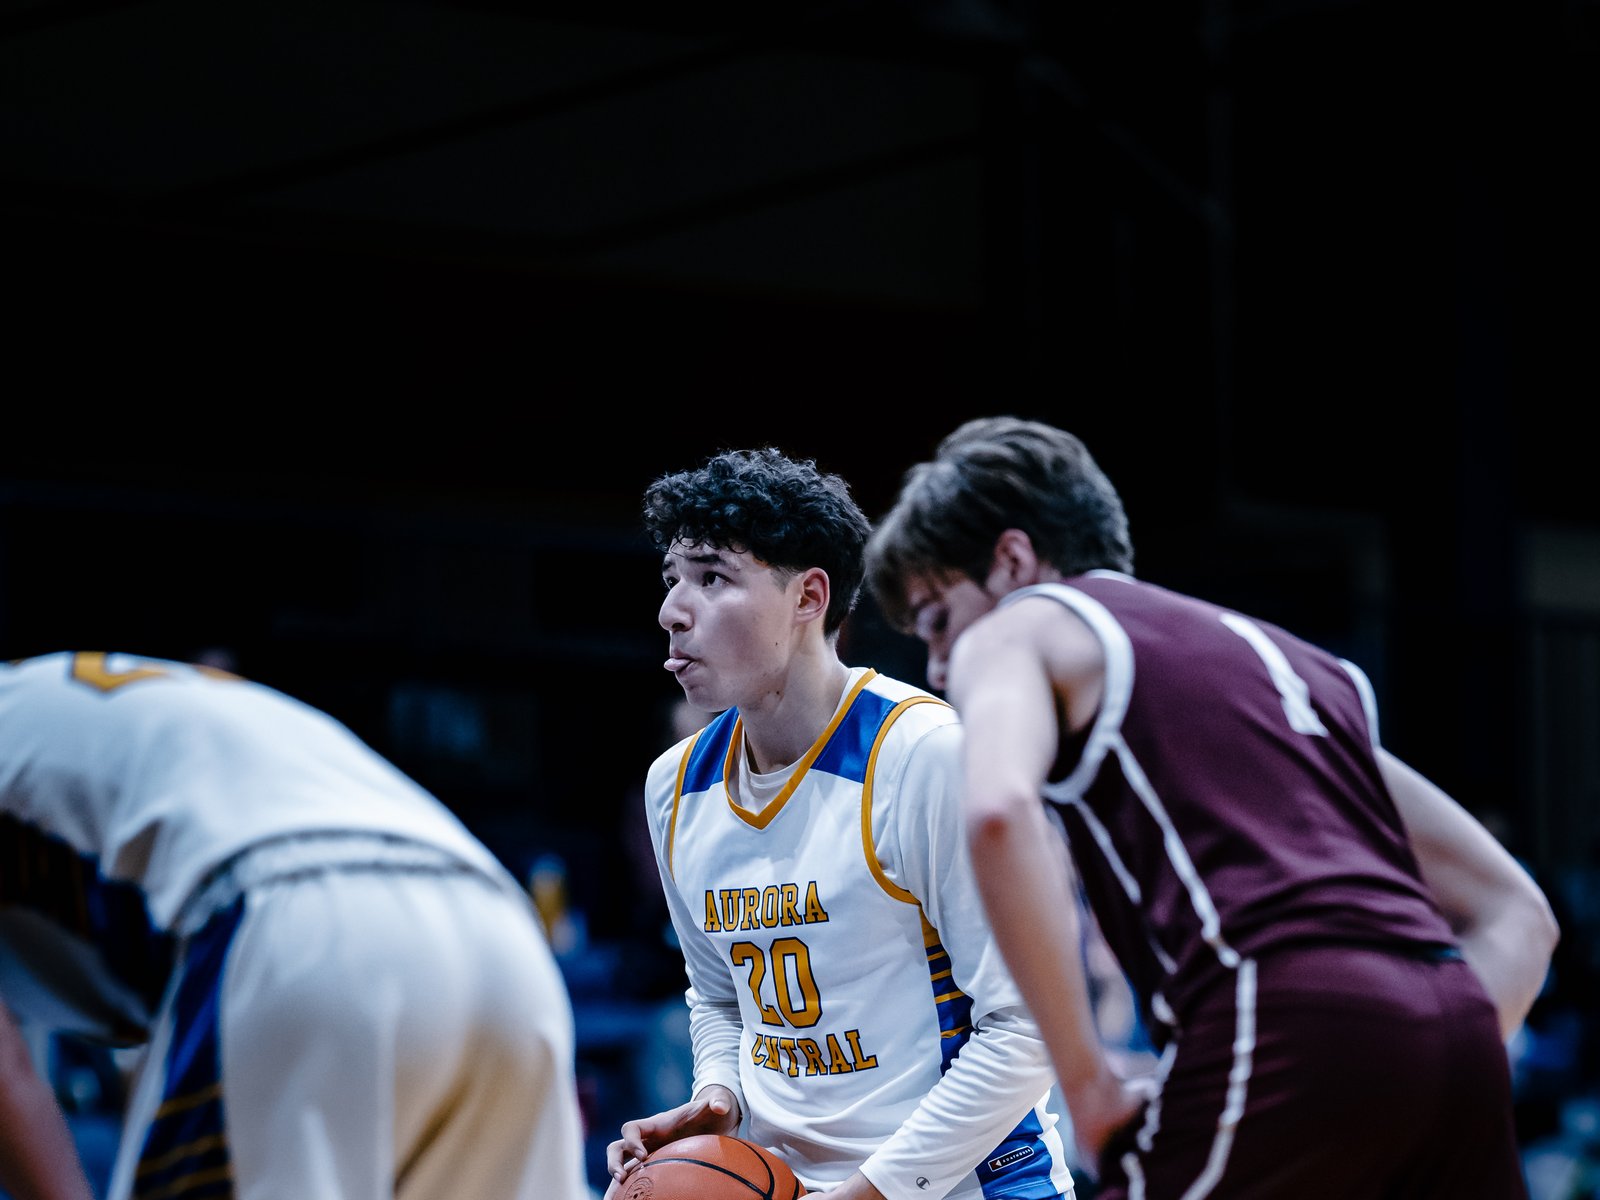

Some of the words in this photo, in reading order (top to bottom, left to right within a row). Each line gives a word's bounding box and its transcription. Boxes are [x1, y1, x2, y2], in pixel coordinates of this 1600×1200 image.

[704, 881, 829, 932] AURORA
[730, 937, 822, 1028] 20
[751, 1029, 879, 1077] CNTRAL
